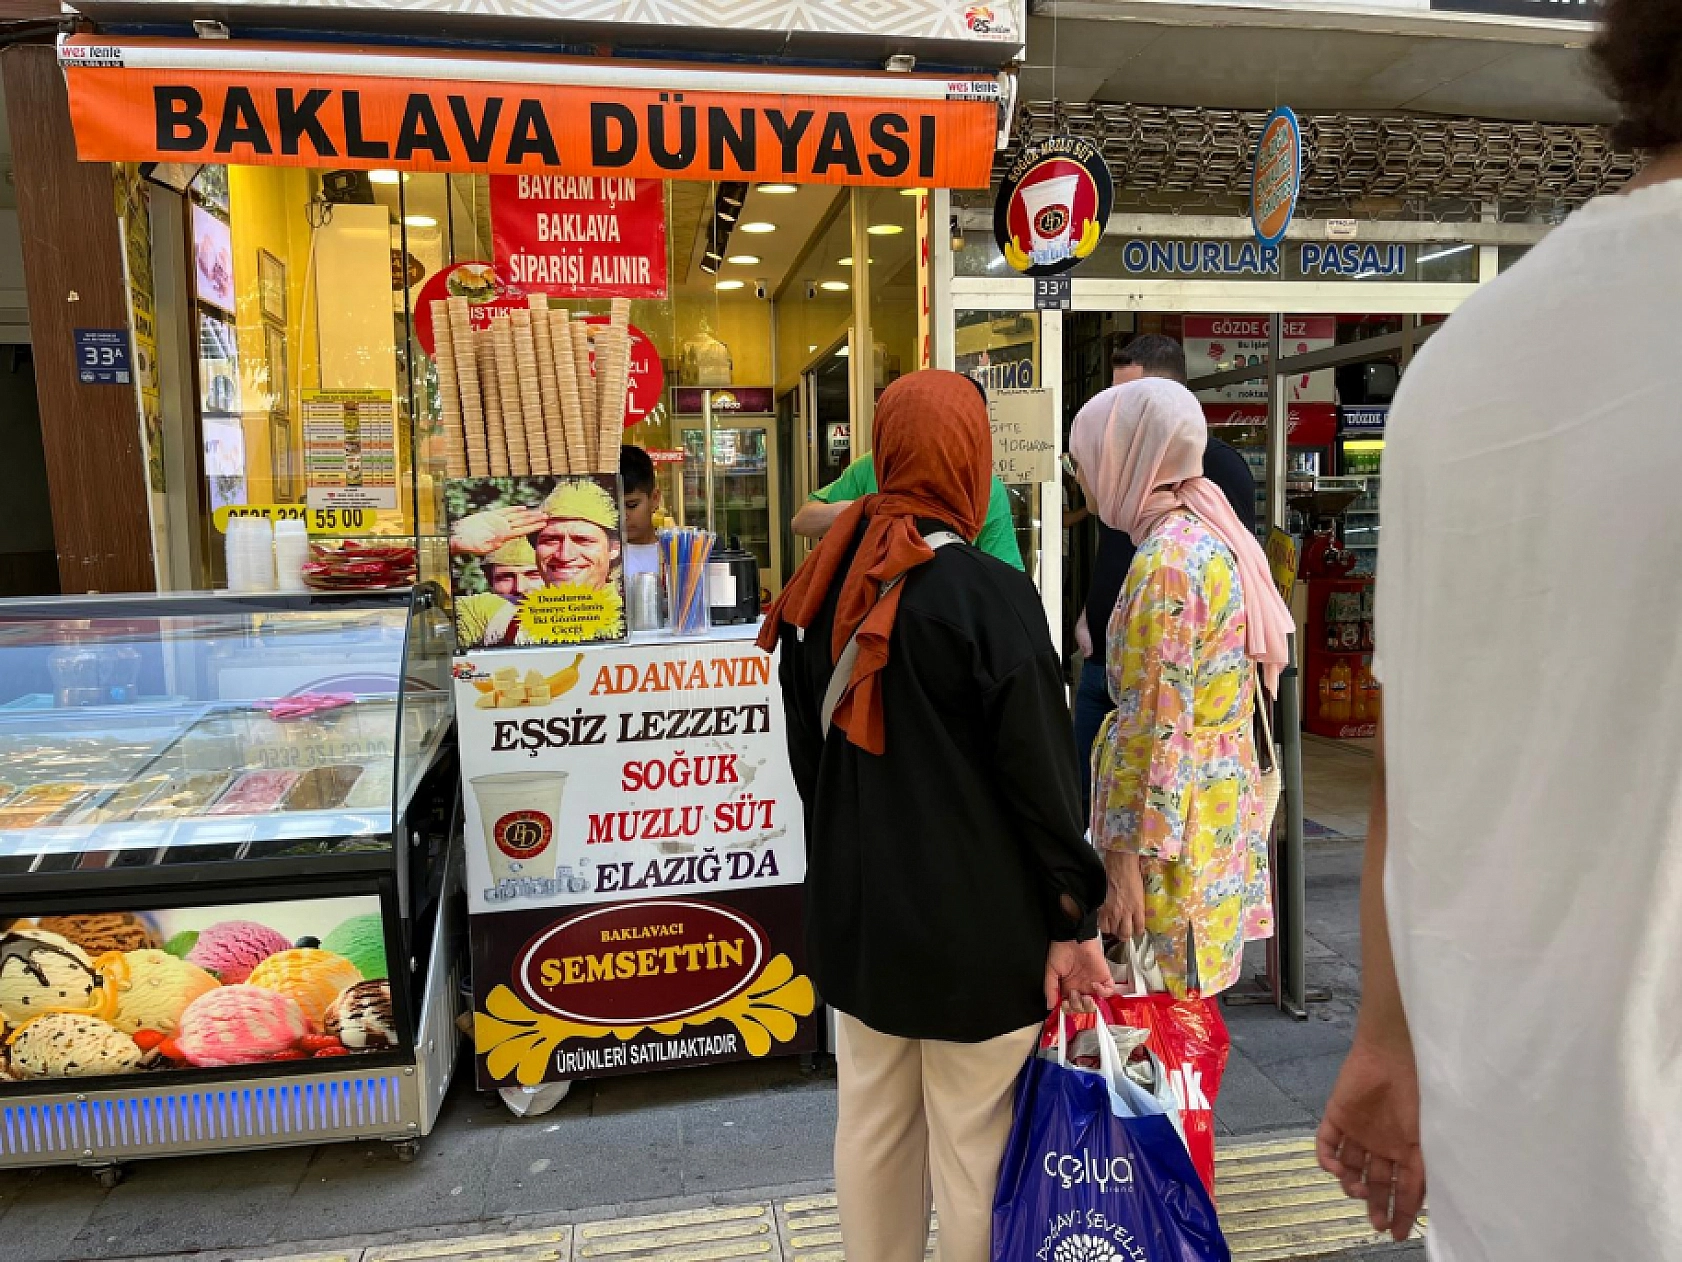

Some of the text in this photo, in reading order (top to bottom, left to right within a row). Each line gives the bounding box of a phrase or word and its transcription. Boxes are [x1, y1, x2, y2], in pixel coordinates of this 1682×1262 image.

[153, 85, 935, 178] BAKLAVA DÜNYASI
[518, 174, 594, 200] BAYRAM
[536, 213, 621, 242] BAKLAVA
[509, 246, 651, 291] SİPARİŞİ ALINIR
[1122, 239, 1406, 275] ONURLAR PASAJI
[1212, 318, 1306, 337] GÖZDE ÇREZ
[315, 509, 336, 529] 55
[341, 508, 363, 528] 00
[589, 655, 770, 696] ADANA'NIN
[491, 697, 770, 758] EŞSİZ LEZZETİ
[621, 749, 739, 792] SOĞUK
[586, 794, 777, 845] MUZLU SÜT
[594, 845, 780, 893] ELAZIĞ'DA
[600, 922, 684, 943] BAKLAVACI
[540, 933, 745, 991] ŞEMSETTİN
[556, 1033, 738, 1074] ÜRÜNLERİ SATILMAKTADIR
